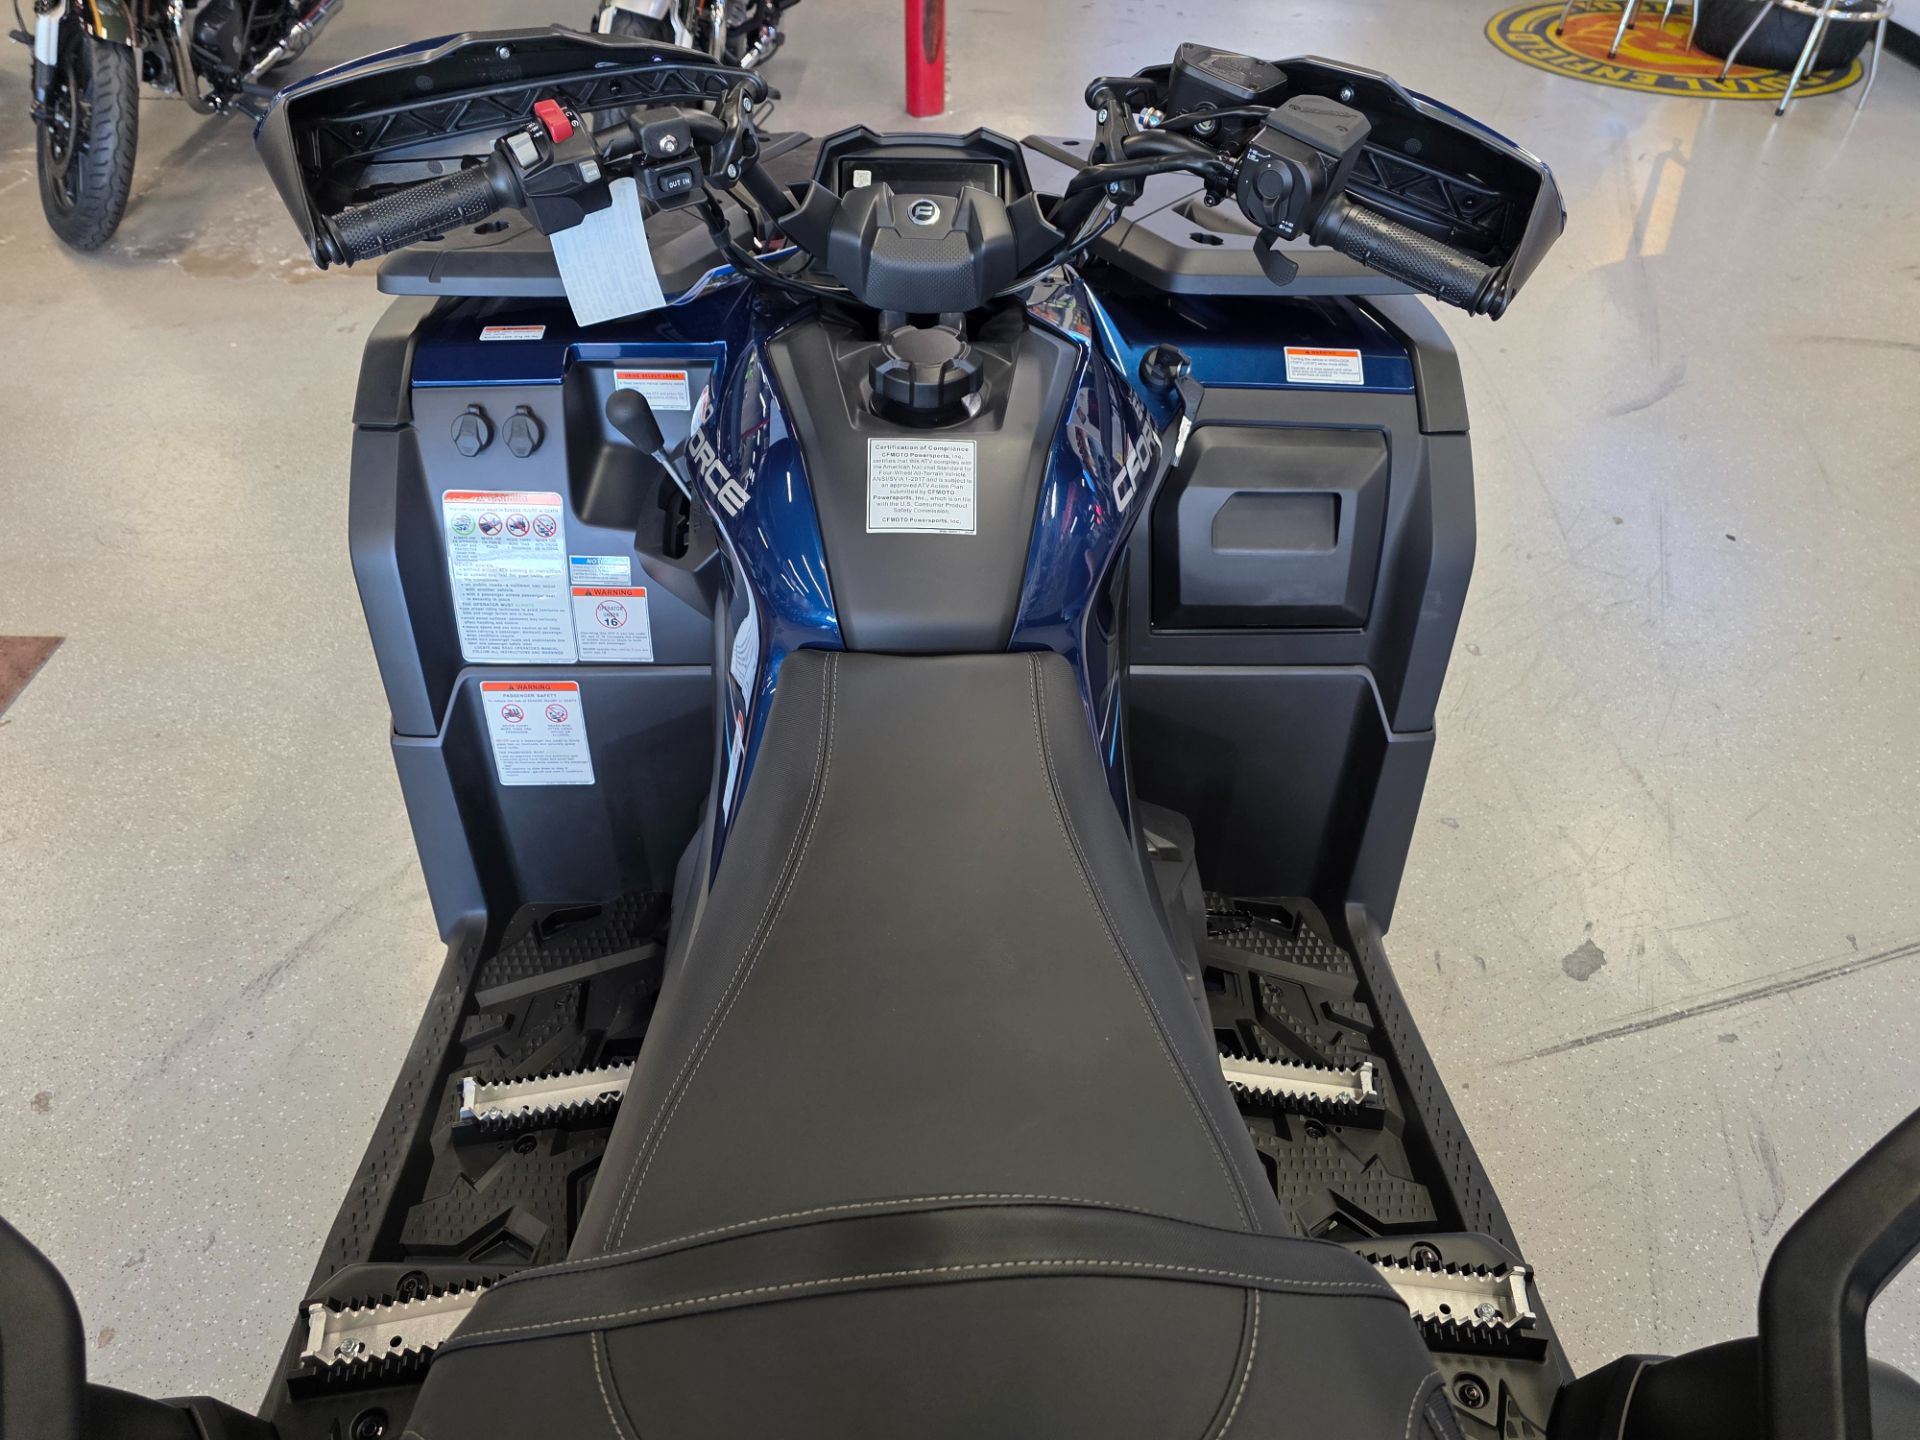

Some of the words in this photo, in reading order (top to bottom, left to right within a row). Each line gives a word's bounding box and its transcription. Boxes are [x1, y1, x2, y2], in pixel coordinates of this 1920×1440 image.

[1507, 31, 1659, 85] ENFIELD
[669, 179, 680, 188] OUT
[682, 177, 690, 185] IN
[928, 445, 969, 453] Compliance
[910, 452, 950, 460] Powersports,
[943, 477, 966, 485] subject
[889, 482, 917, 490] approved
[604, 618, 618, 627] 16
